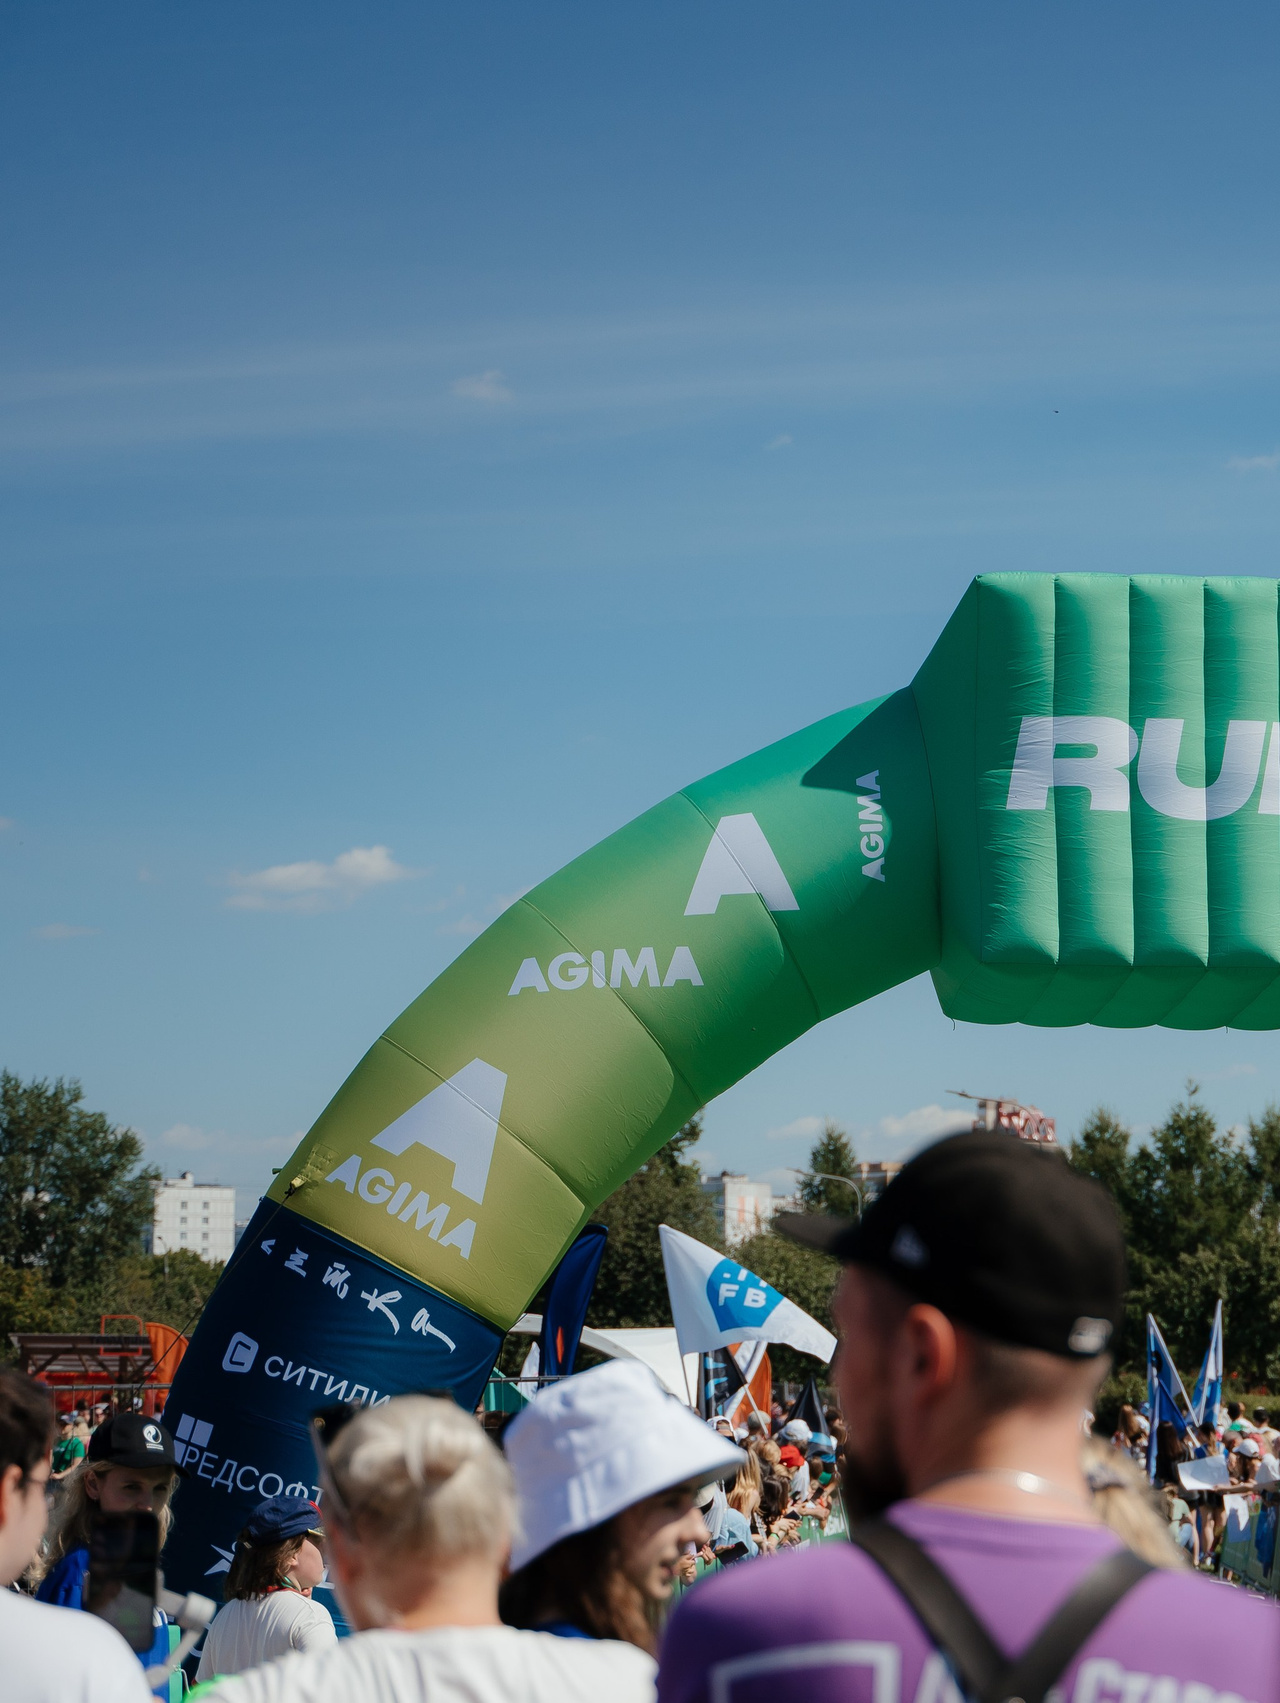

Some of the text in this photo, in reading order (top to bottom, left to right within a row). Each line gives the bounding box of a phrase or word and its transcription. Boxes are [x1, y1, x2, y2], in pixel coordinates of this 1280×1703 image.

[855, 769, 886, 883] AGIMA
[508, 946, 704, 996] AGIMA
[325, 1154, 477, 1261] AGIMA
[264, 1355, 391, 1409] СИТИЛИ
